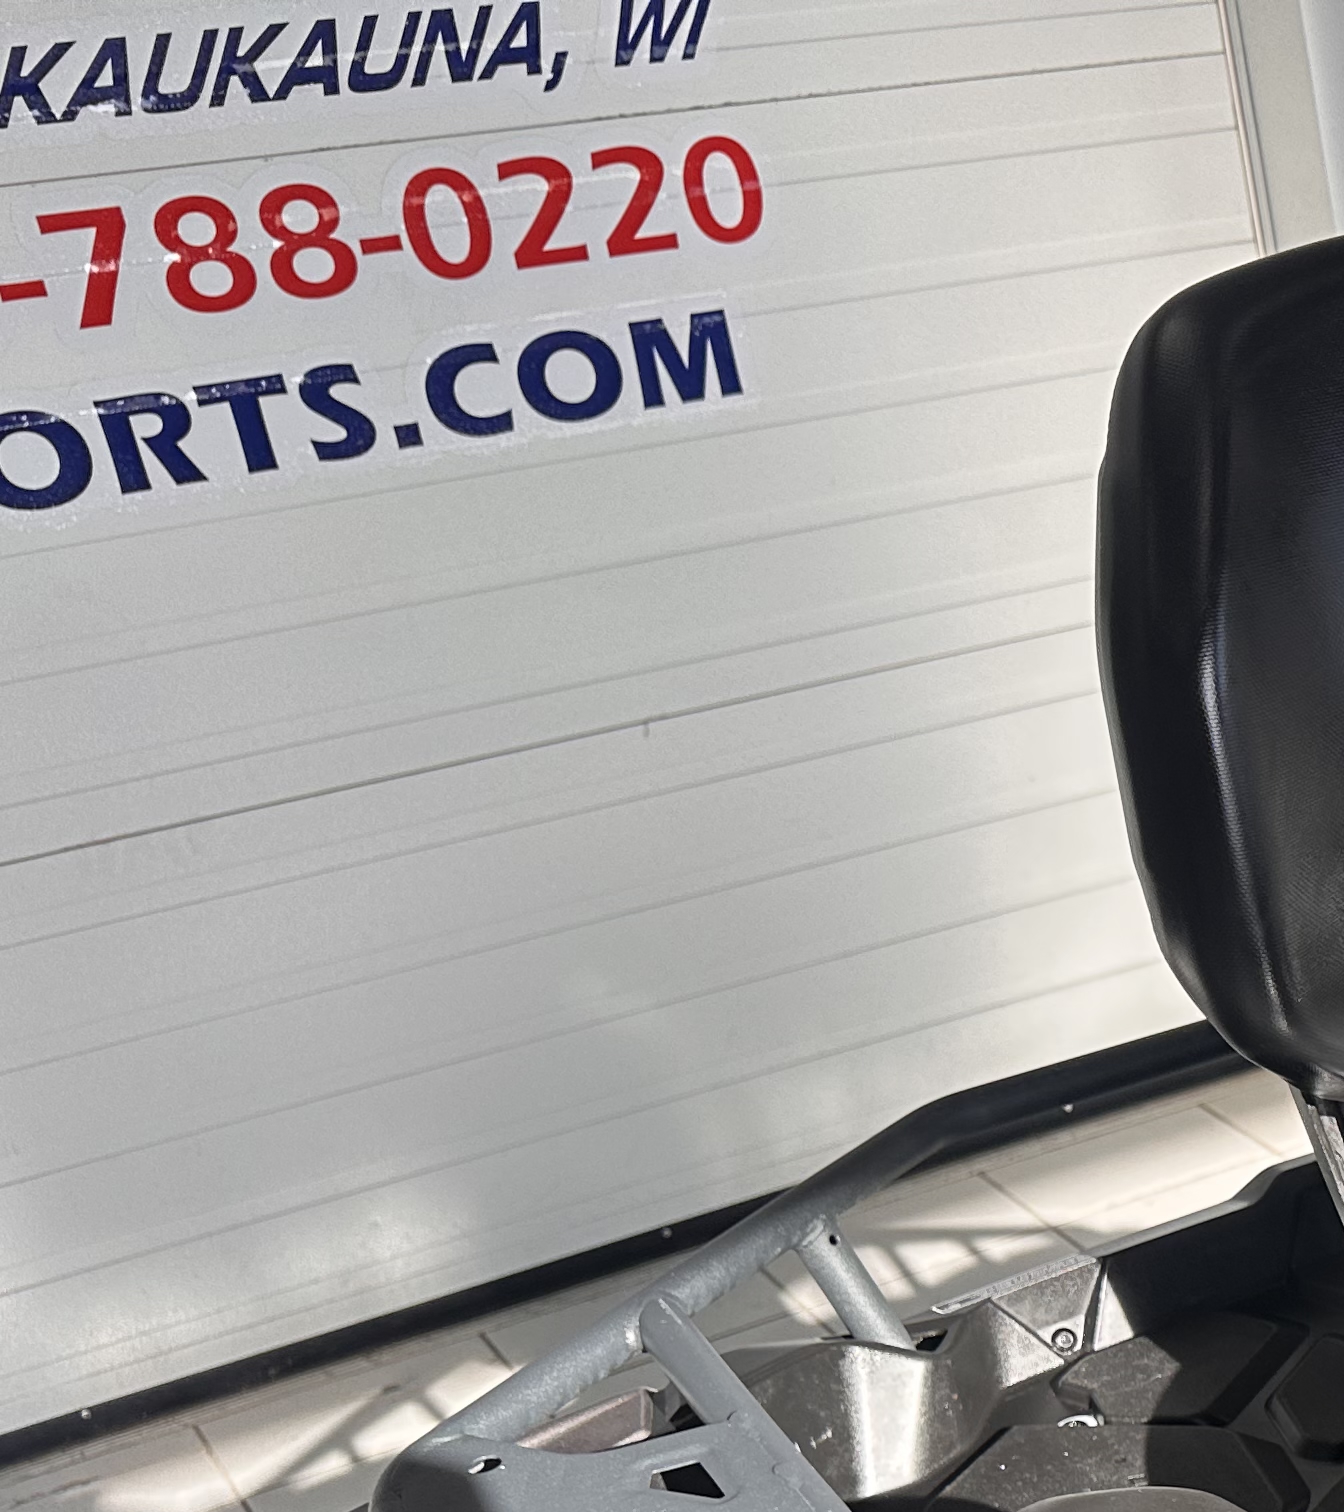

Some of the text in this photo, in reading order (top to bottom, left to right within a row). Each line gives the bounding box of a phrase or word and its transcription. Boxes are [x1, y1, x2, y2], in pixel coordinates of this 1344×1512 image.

[0, 0, 712, 130] KAUKAUNA, WI
[0, 309, 744, 512] ORTS.COM
